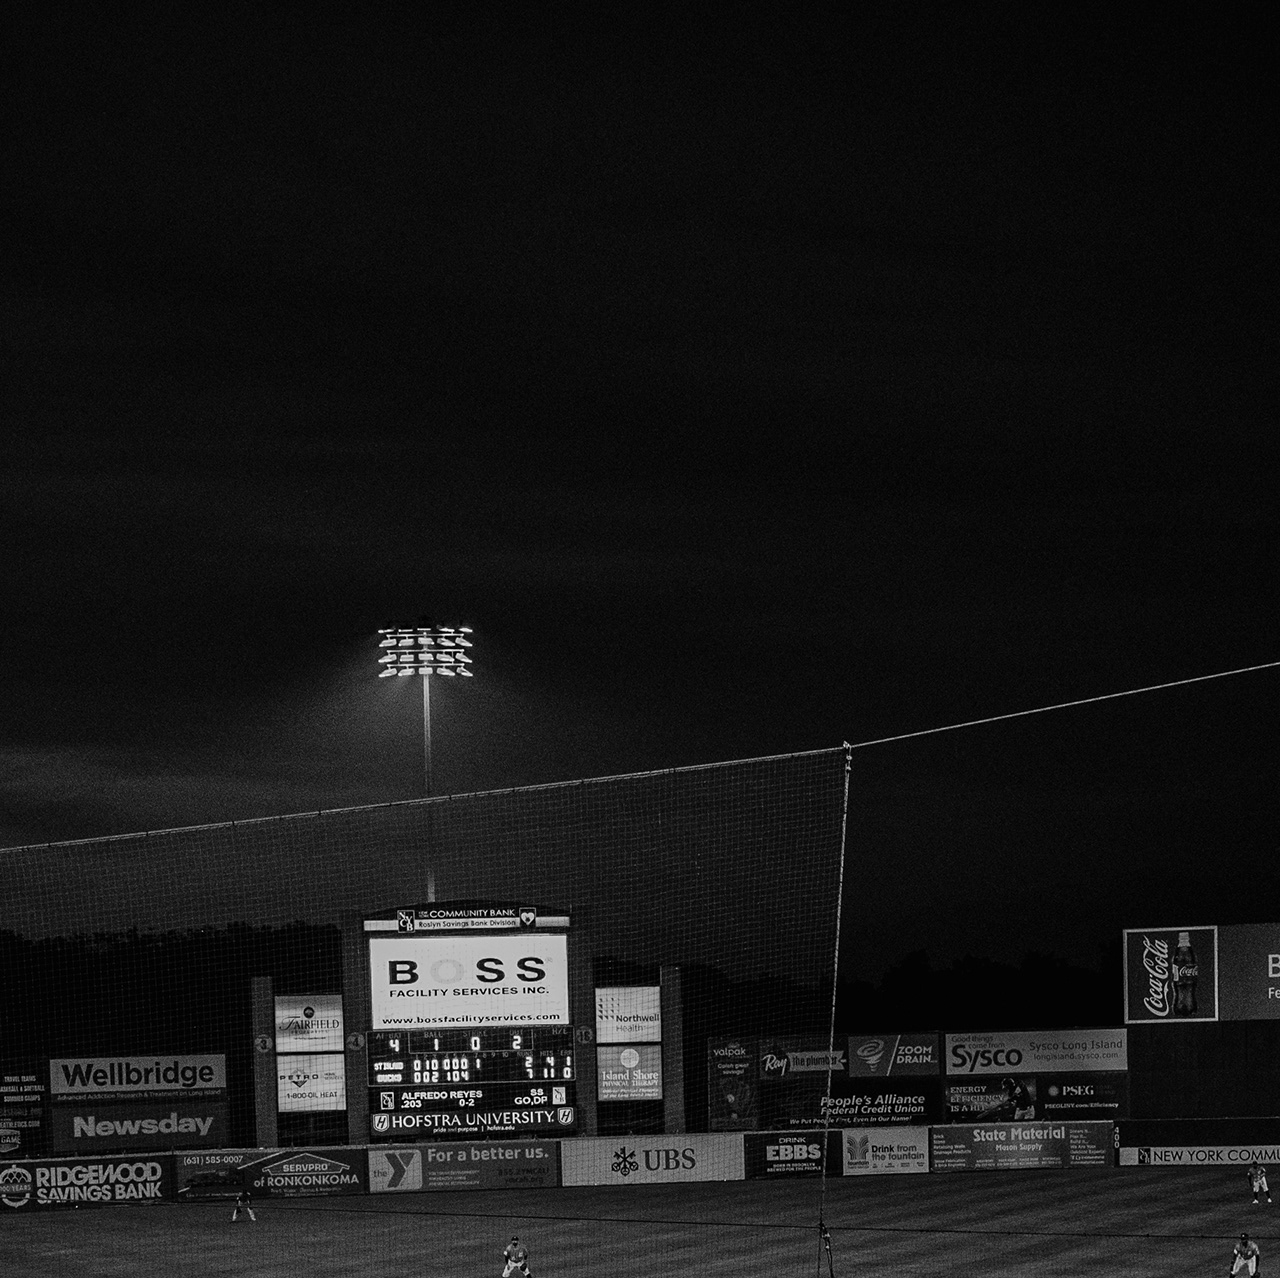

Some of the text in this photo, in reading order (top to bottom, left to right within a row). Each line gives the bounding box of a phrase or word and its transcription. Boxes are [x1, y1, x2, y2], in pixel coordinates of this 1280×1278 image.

[429, 909, 488, 919] COMMUNITY
[489, 908, 516, 917] BANK
[442, 921, 469, 929] Savings
[389, 986, 550, 998] FACILITY SERVICES INC.
[278, 1015, 340, 1031] FAIRFIELD
[382, 1013, 561, 1025] www.bossfacilityservices.com
[616, 1013, 660, 1023] Northwell
[898, 1045, 933, 1055] ZOOM
[1029, 1039, 1123, 1052] Sysco Long Island
[712, 1047, 747, 1058] valpak
[951, 1044, 1023, 1072] Sysco
[1033, 1051, 1119, 1061] longisland.sysco.com
[896, 1054, 932, 1065] DRAIN
[762, 1054, 788, 1077] Ray
[61, 1060, 214, 1088] Wellbridge
[602, 1069, 659, 1080] Island Shore
[401, 1090, 483, 1100] ALFREDO REYES
[950, 1085, 987, 1094] ENERGY
[1062, 1085, 1095, 1096] PSEG
[820, 1093, 926, 1108] People's Alliance
[950, 1094, 1006, 1104] EFFICIENCY
[820, 1104, 925, 1116] Federal Credit Union
[73, 1112, 214, 1138] Newsday
[391, 1114, 462, 1129] HOFSTRA
[973, 1126, 1066, 1142] State Material
[765, 1144, 822, 1161] EBBS
[871, 1144, 917, 1153] Drink from
[995, 1142, 1043, 1152] Mason Supply
[205, 1155, 244, 1165] 585-0007
[427, 1147, 550, 1162] For a better us.
[642, 1148, 696, 1172] UBS
[871, 1152, 925, 1161] the fountain
[1153, 1150, 1183, 1161] NEW
[1186, 1150, 1224, 1161] YORK
[282, 1163, 329, 1172] SERVPRO
[35, 1162, 163, 1187] RIDGEWOOD
[373, 1169, 388, 1178] the
[253, 1174, 360, 1188] of RONKONKOMA
[36, 1181, 163, 1205] SAVINGS BANK
